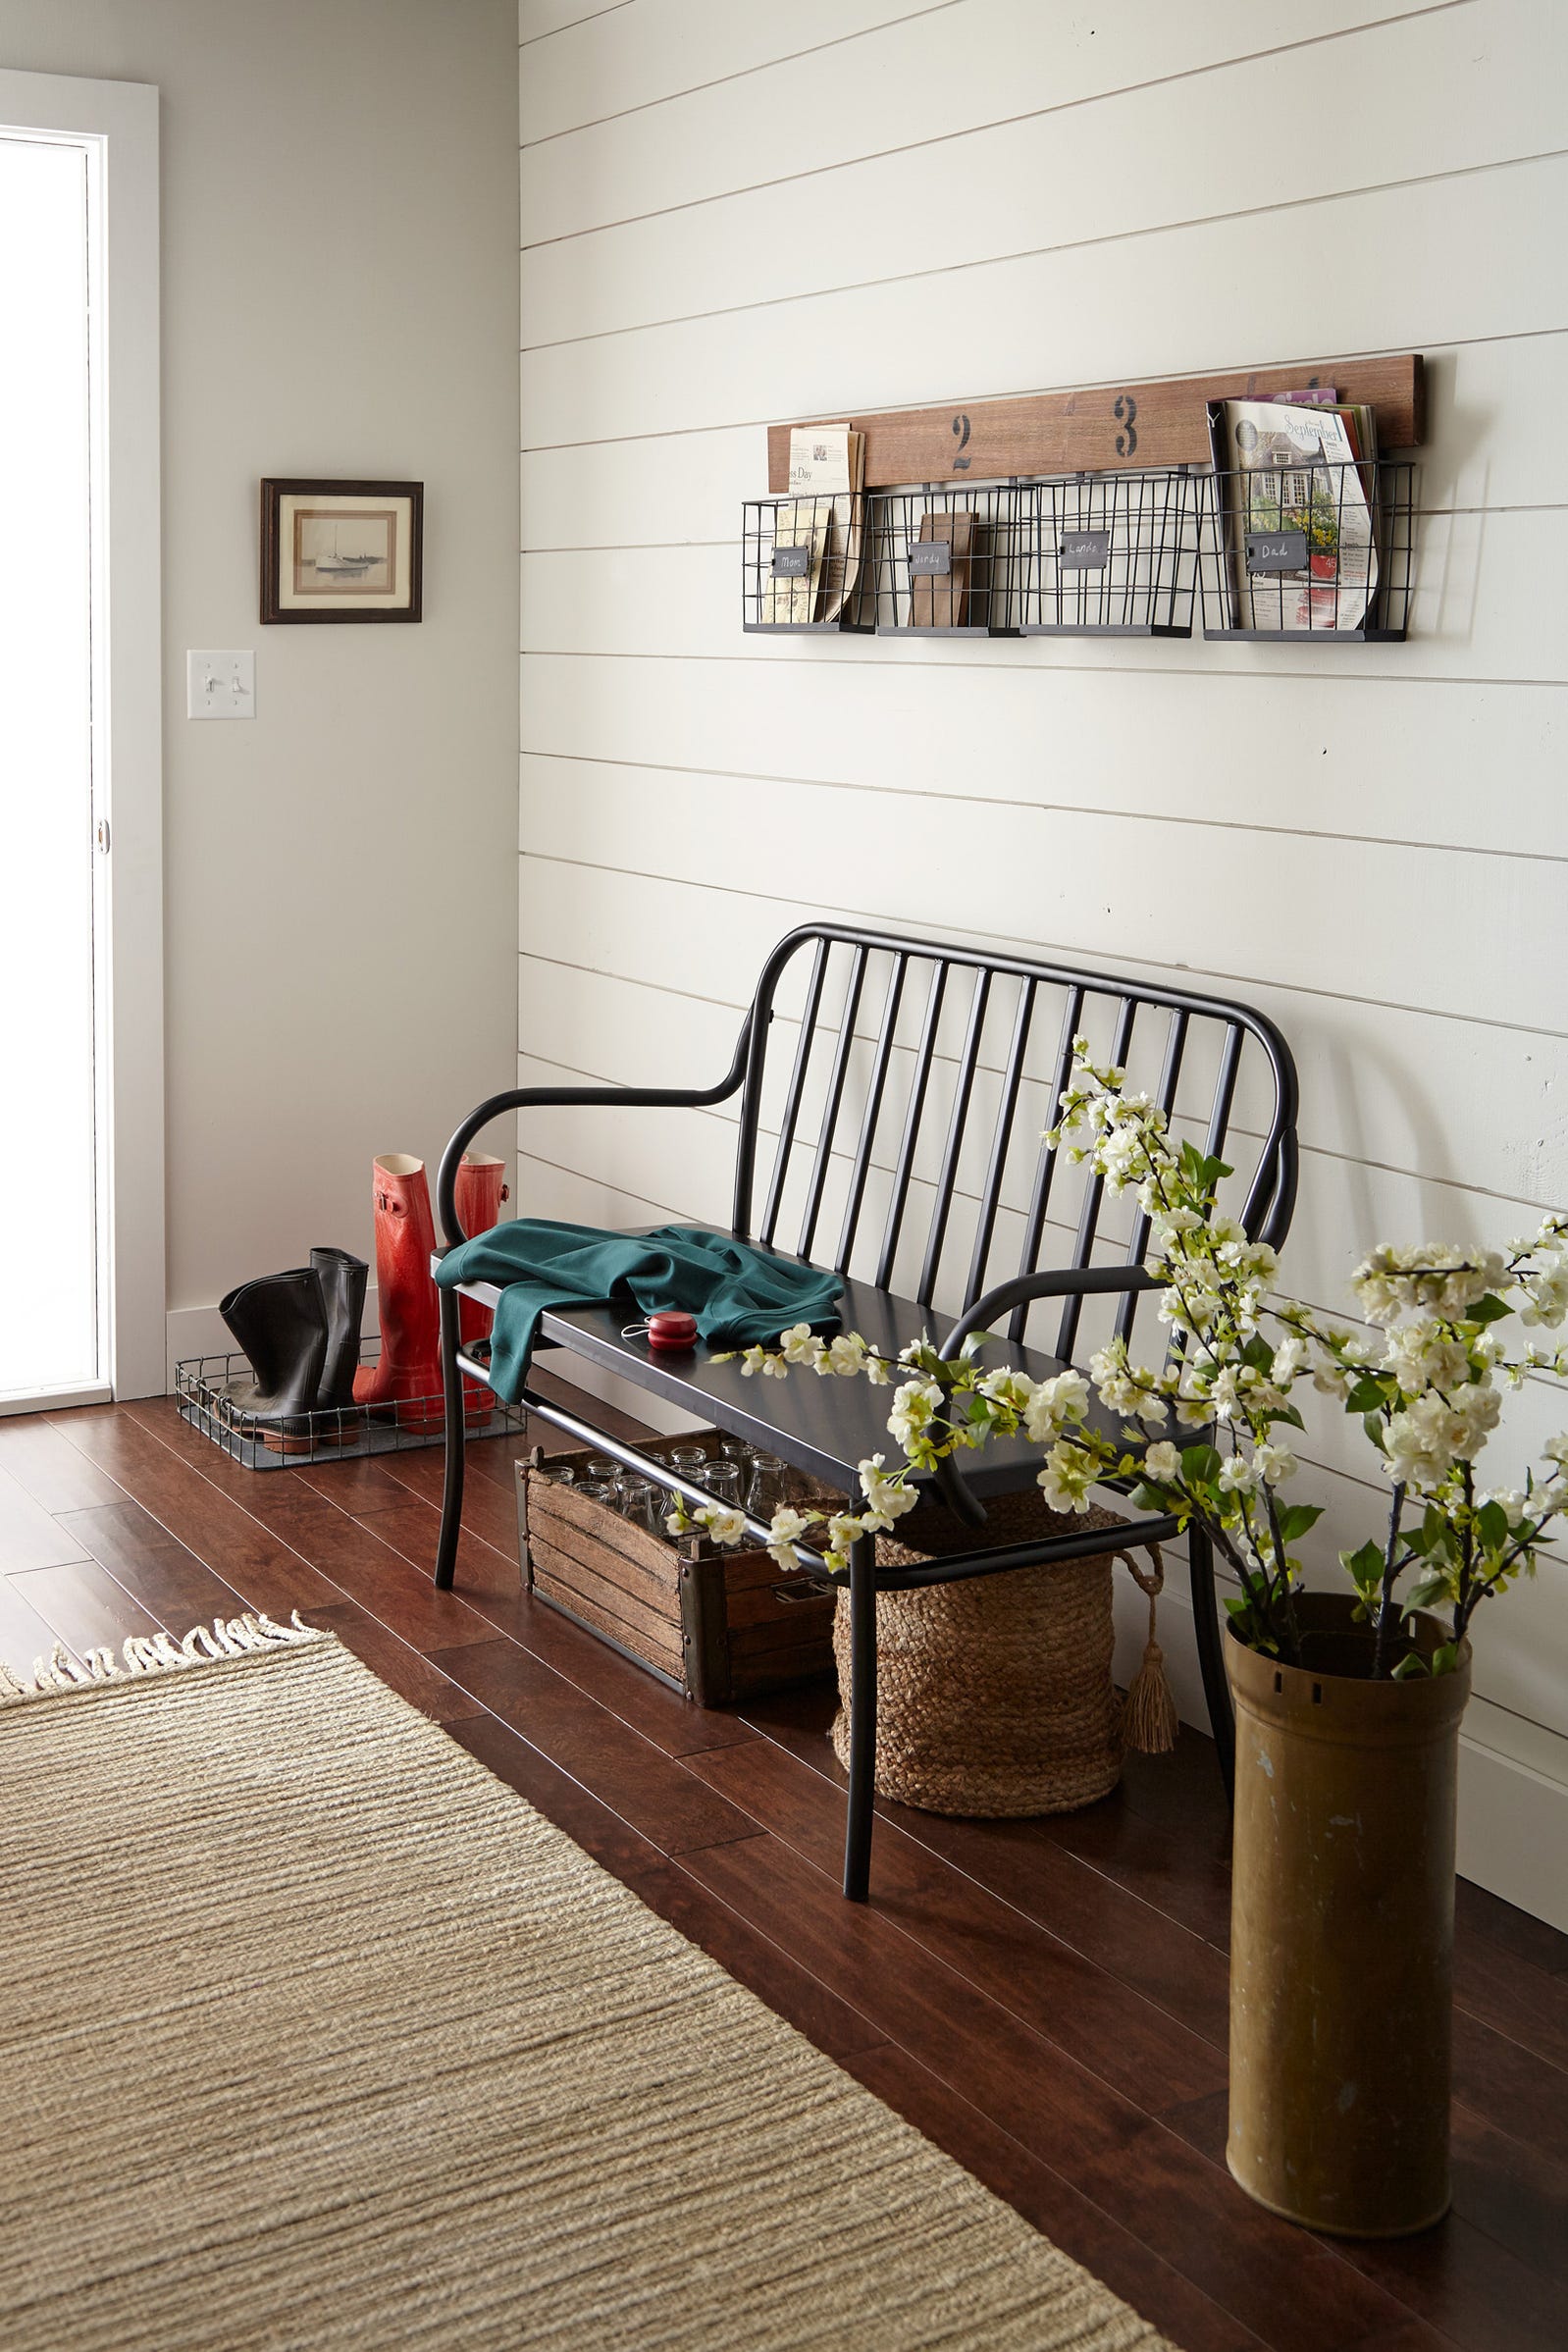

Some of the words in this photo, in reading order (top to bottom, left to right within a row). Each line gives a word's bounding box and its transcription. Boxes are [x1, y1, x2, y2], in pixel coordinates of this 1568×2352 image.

[1114, 394, 1137, 458] 3
[1283, 414, 1337, 441] September
[952, 414, 972, 471] 2
[798, 467, 811, 481] Day
[1262, 542, 1288, 558] Dad
[781, 556, 802, 567] Mom
